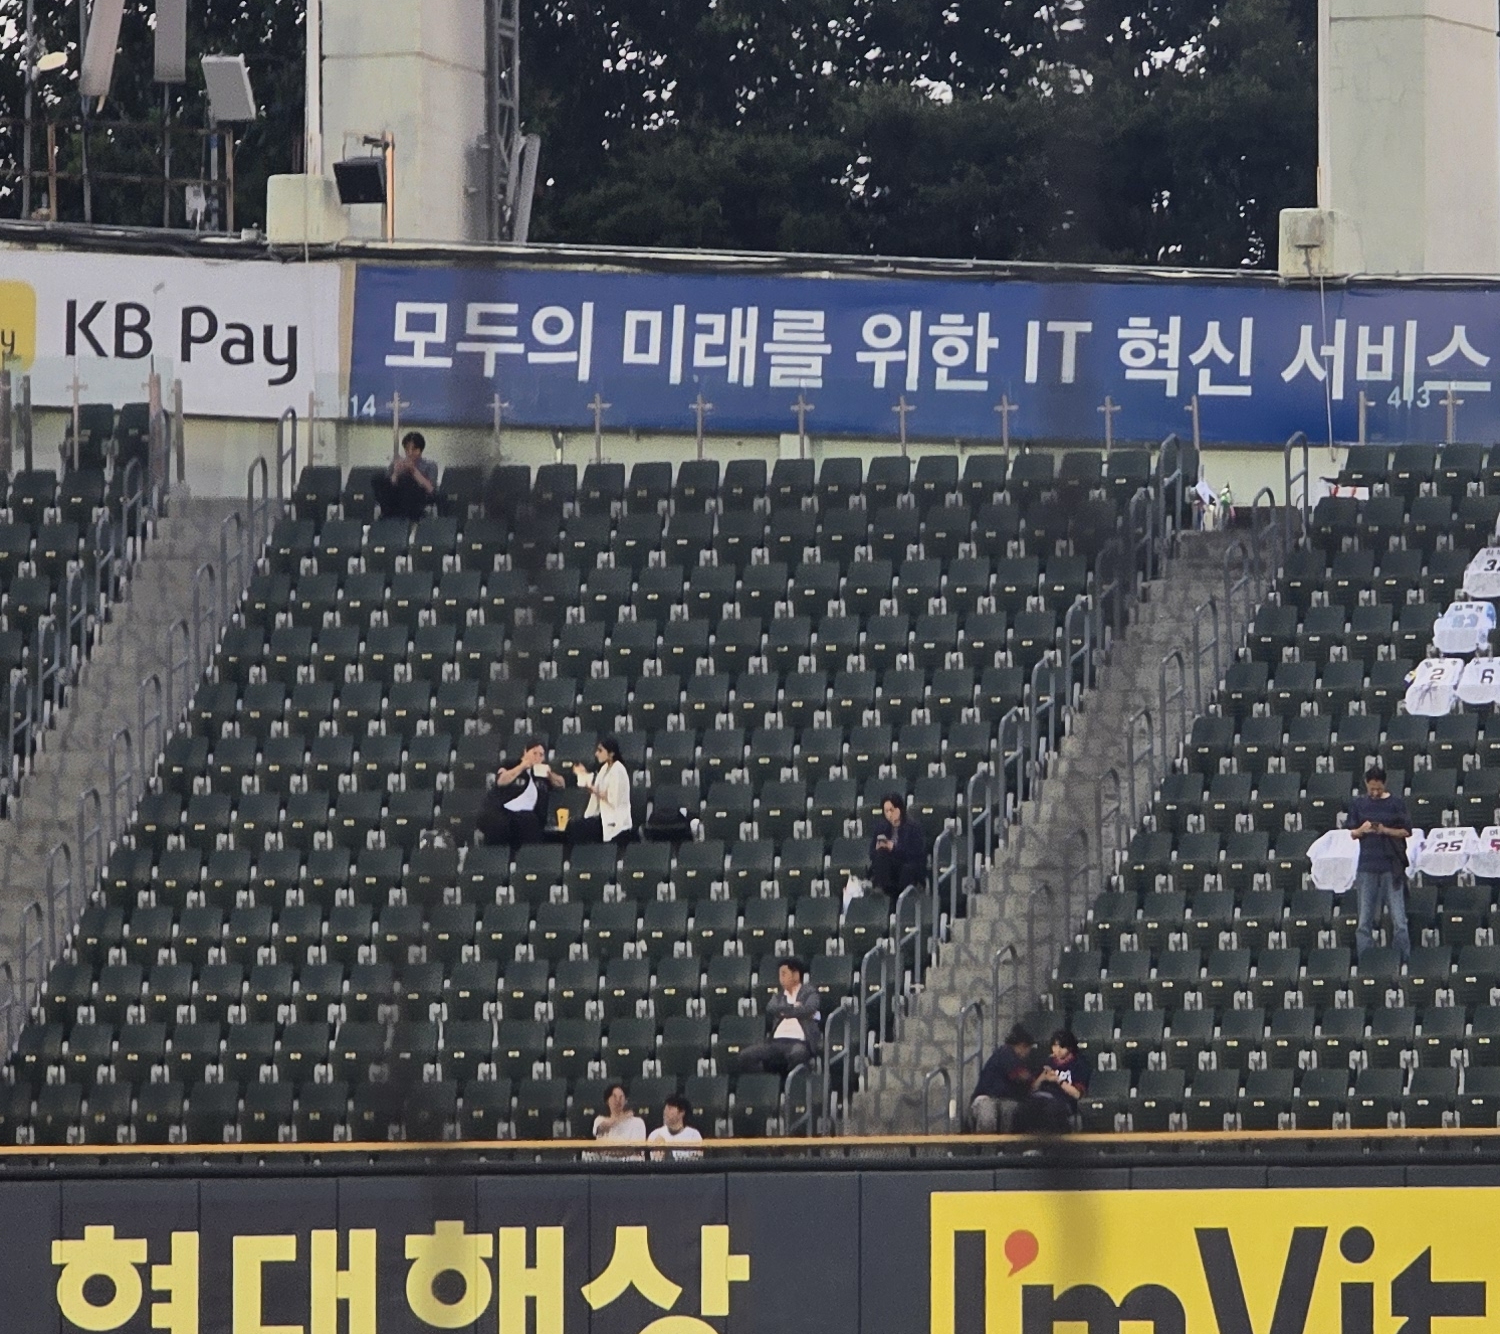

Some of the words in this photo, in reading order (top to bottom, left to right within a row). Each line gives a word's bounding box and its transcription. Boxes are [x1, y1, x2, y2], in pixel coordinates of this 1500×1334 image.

[65, 299, 154, 359] KB
[181, 305, 298, 386] Pay
[385, 300, 594, 383] 모두의
[623, 304, 832, 389] 미래를
[856, 310, 999, 392] 위한
[1025, 320, 1093, 384] IT
[1116, 315, 1254, 398] 혁신
[1280, 319, 1493, 402] 서비스
[1429, 668, 1445, 681] 2
[1480, 669, 1494, 684] 6
